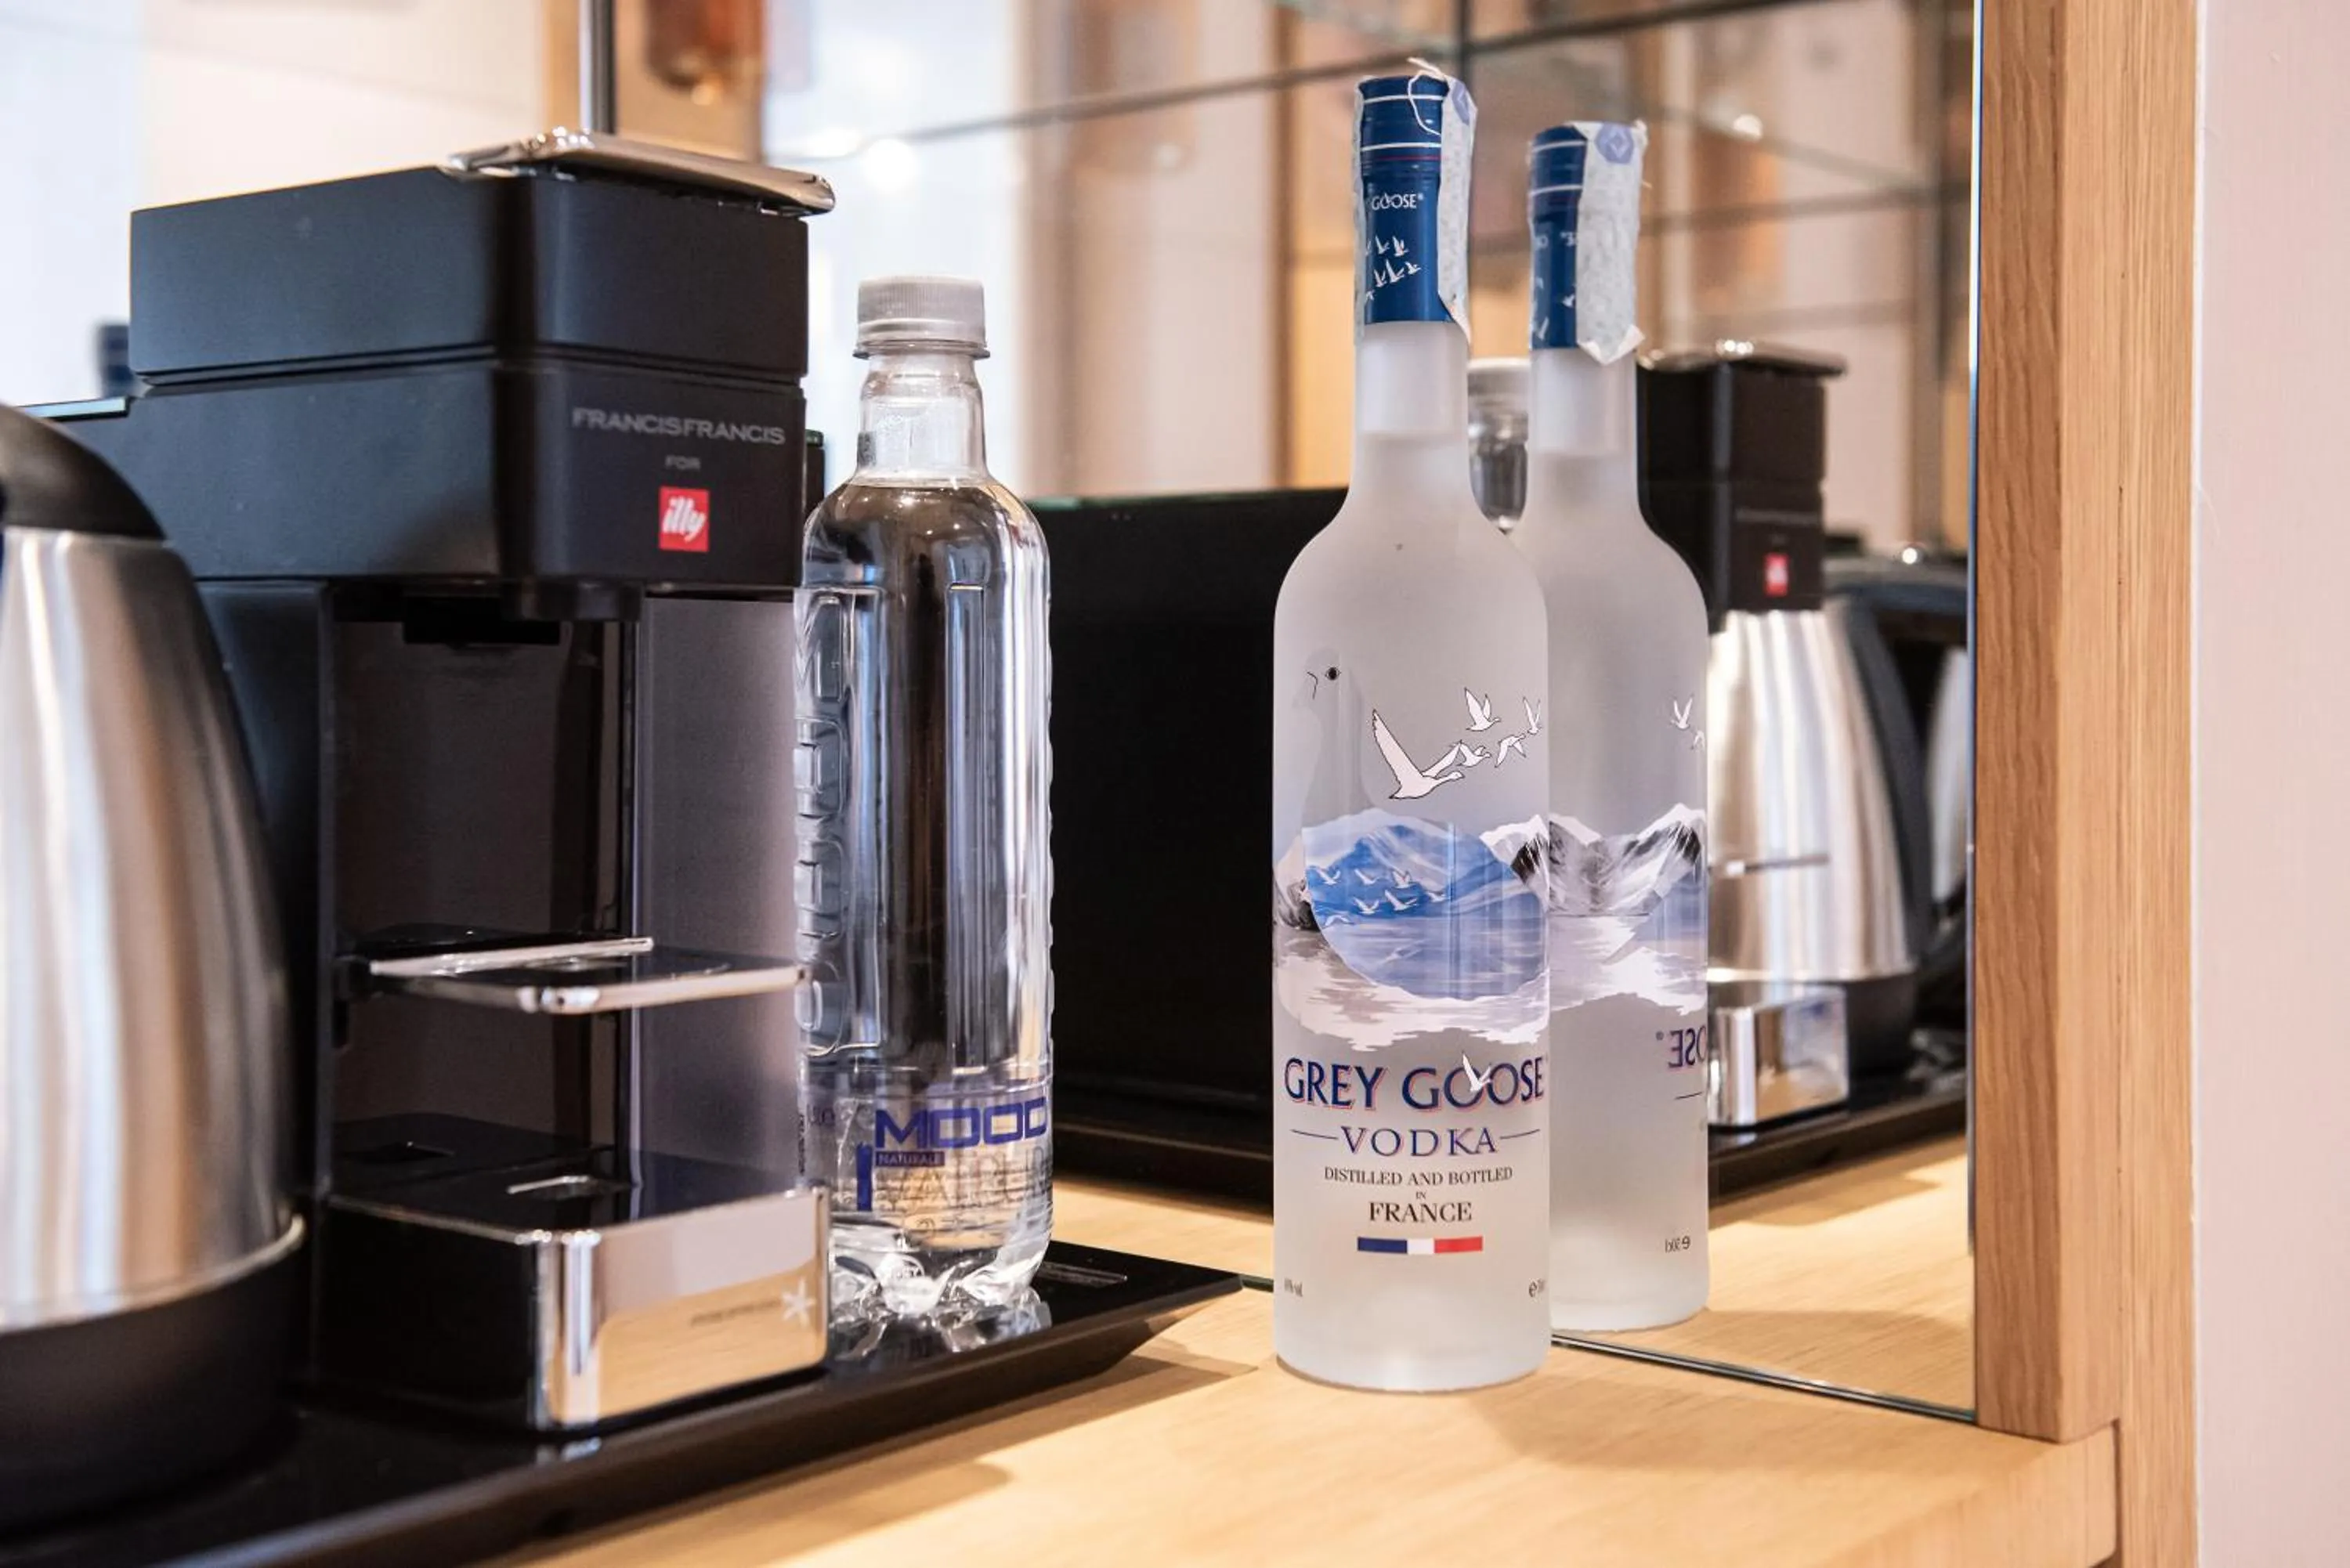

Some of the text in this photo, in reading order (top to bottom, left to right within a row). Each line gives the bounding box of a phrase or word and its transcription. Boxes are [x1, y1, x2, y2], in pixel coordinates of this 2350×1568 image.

[1372, 193, 1417, 210] GOOSE
[572, 407, 786, 446] FRANCISFRANCIS
[666, 456, 700, 470] FOR
[662, 496, 707, 543] illy
[1284, 1055, 1545, 1111] GREY GOOSE
[1340, 1125, 1498, 1157] VODKA
[1324, 1166, 1513, 1186] DISTILLED AND BOTTLED
[1415, 1191, 1426, 1200] IN
[1368, 1201, 1473, 1223] FRANCE
